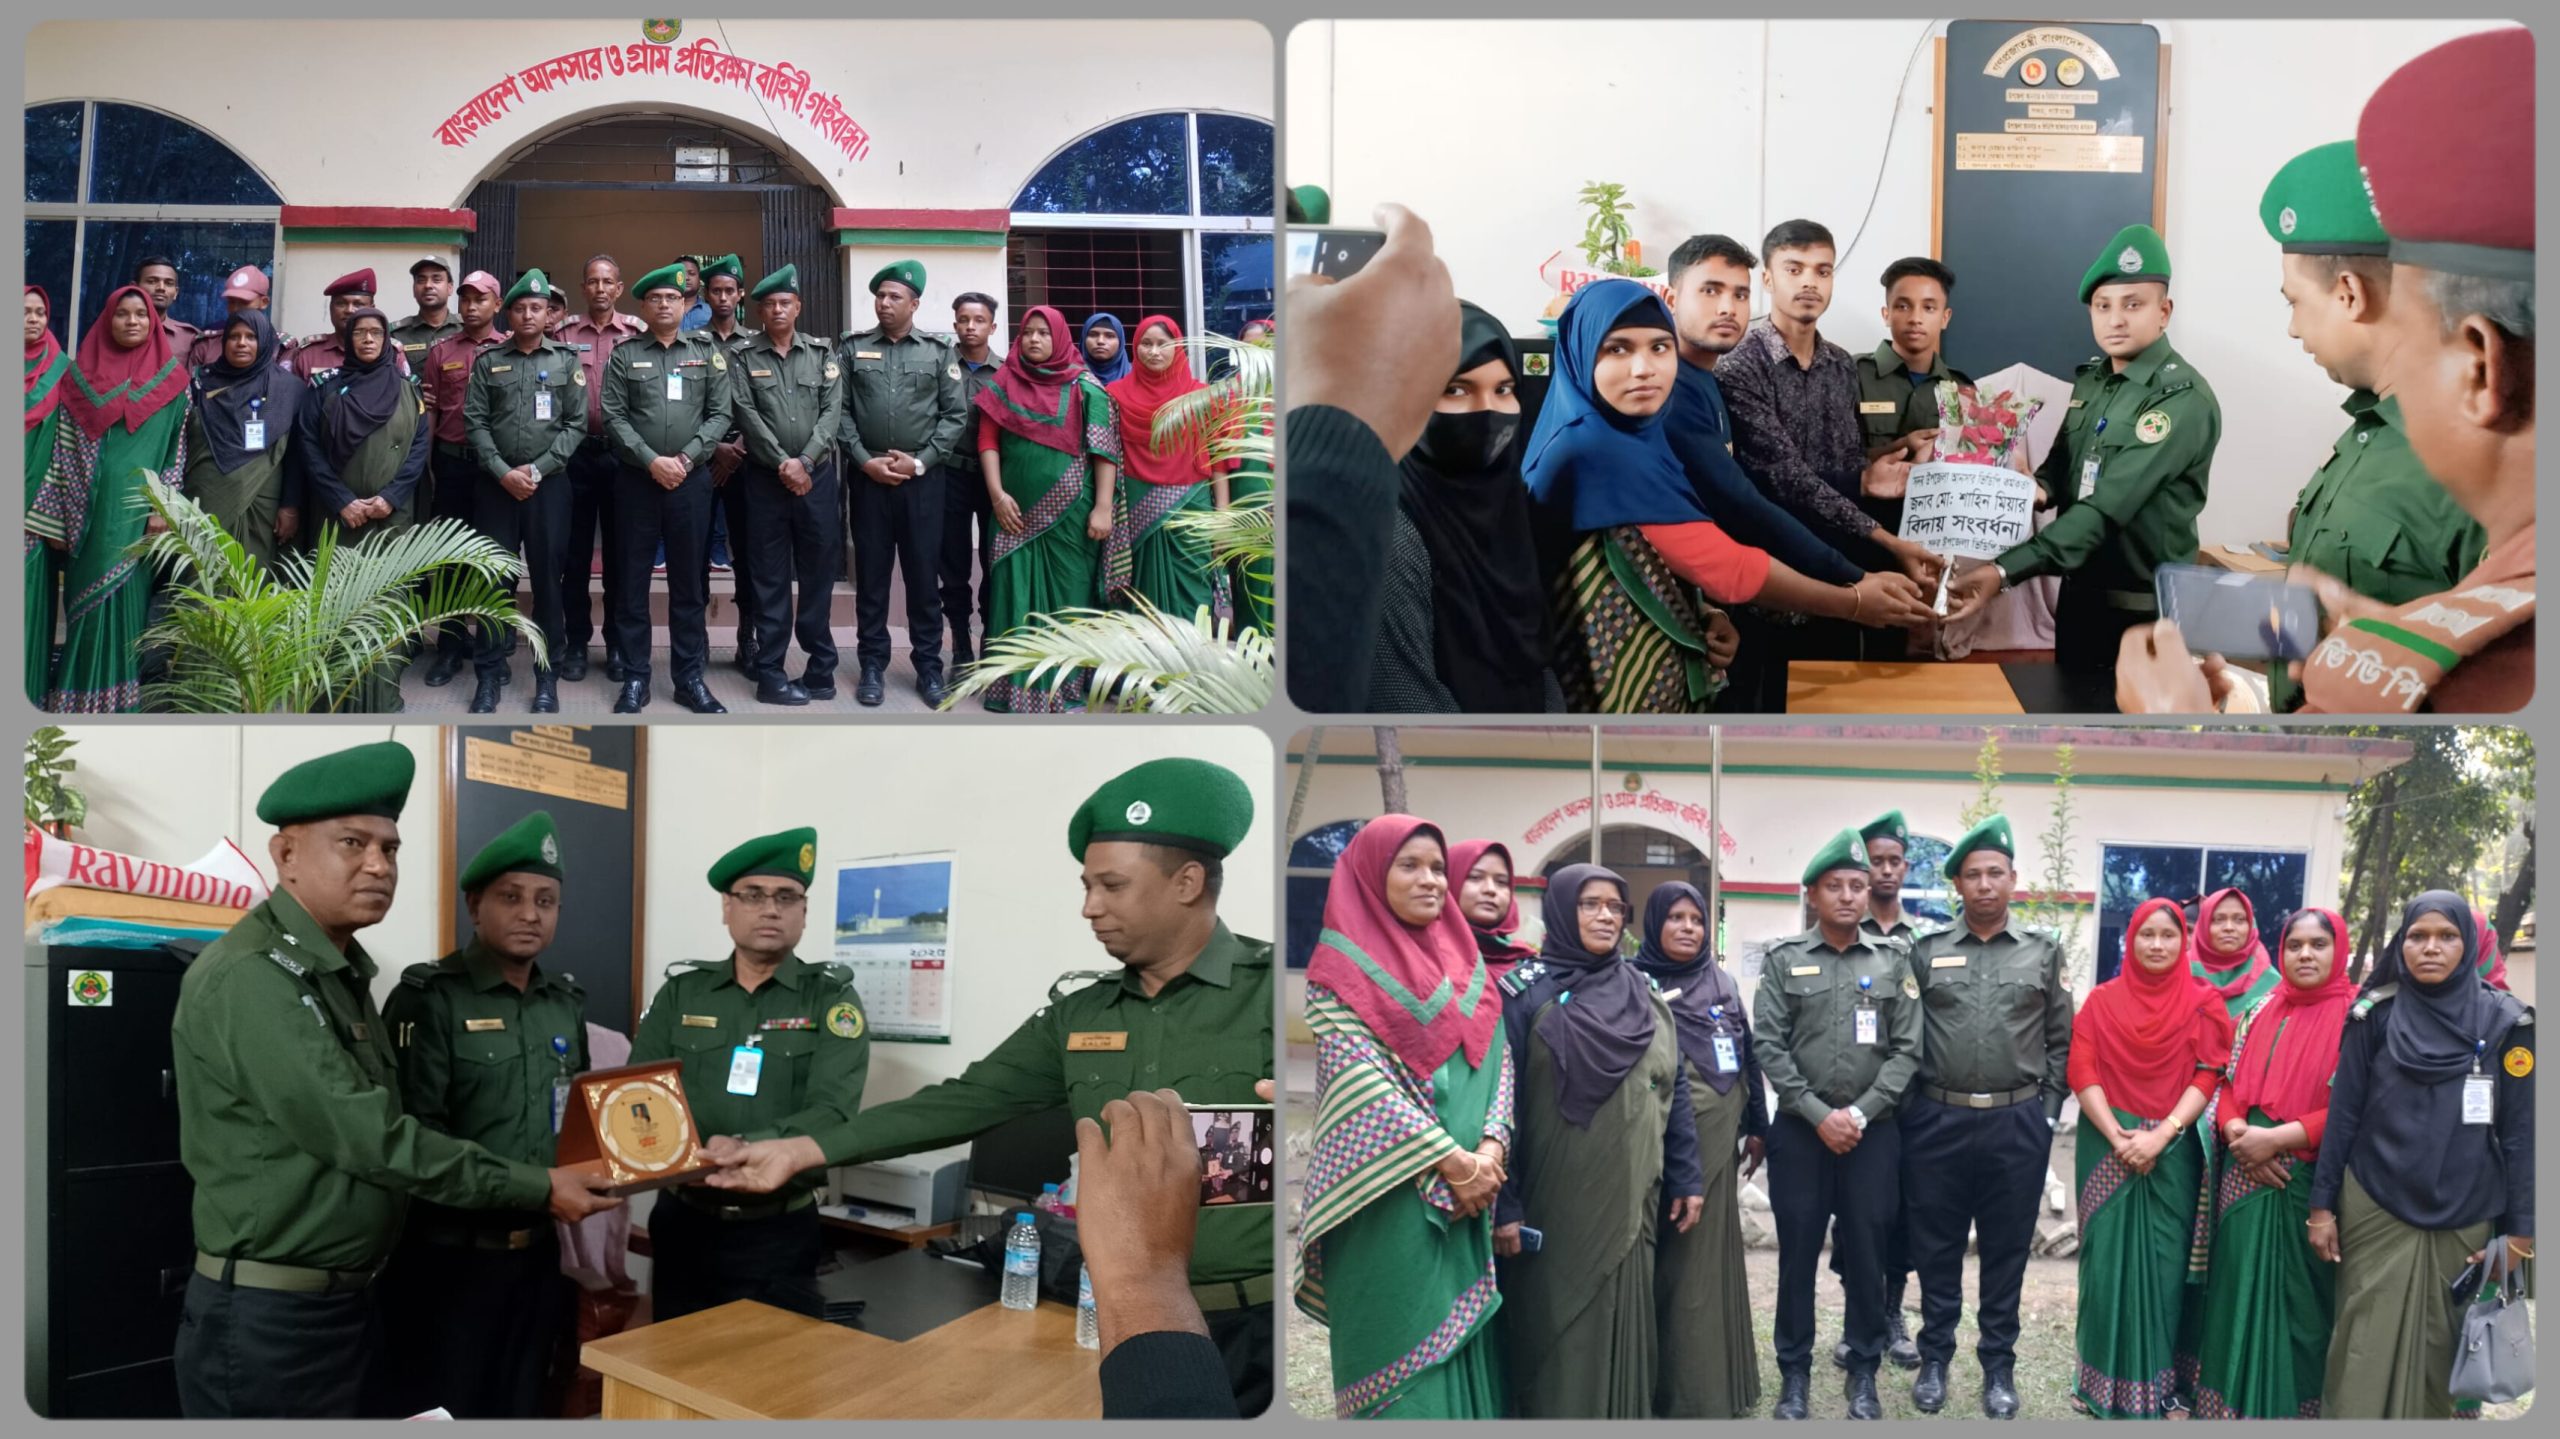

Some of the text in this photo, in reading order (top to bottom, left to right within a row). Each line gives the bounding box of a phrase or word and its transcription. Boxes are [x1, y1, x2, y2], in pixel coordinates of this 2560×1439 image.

[432, 73, 525, 148] বাংলাদেশ
[519, 46, 604, 94] আনসার
[606, 45, 624, 76] ও
[627, 38, 671, 75] গ্রাম
[674, 37, 757, 92] প্রতিরক্ষা
[1910, 494, 1935, 512] জনাব
[1958, 488, 1992, 511] শাহিন
[1995, 491, 2028, 513] মিয়ার
[1906, 513, 2025, 541] বিদায় সংবর্ধনা
[2315, 637, 2427, 711] ভিডিপি
